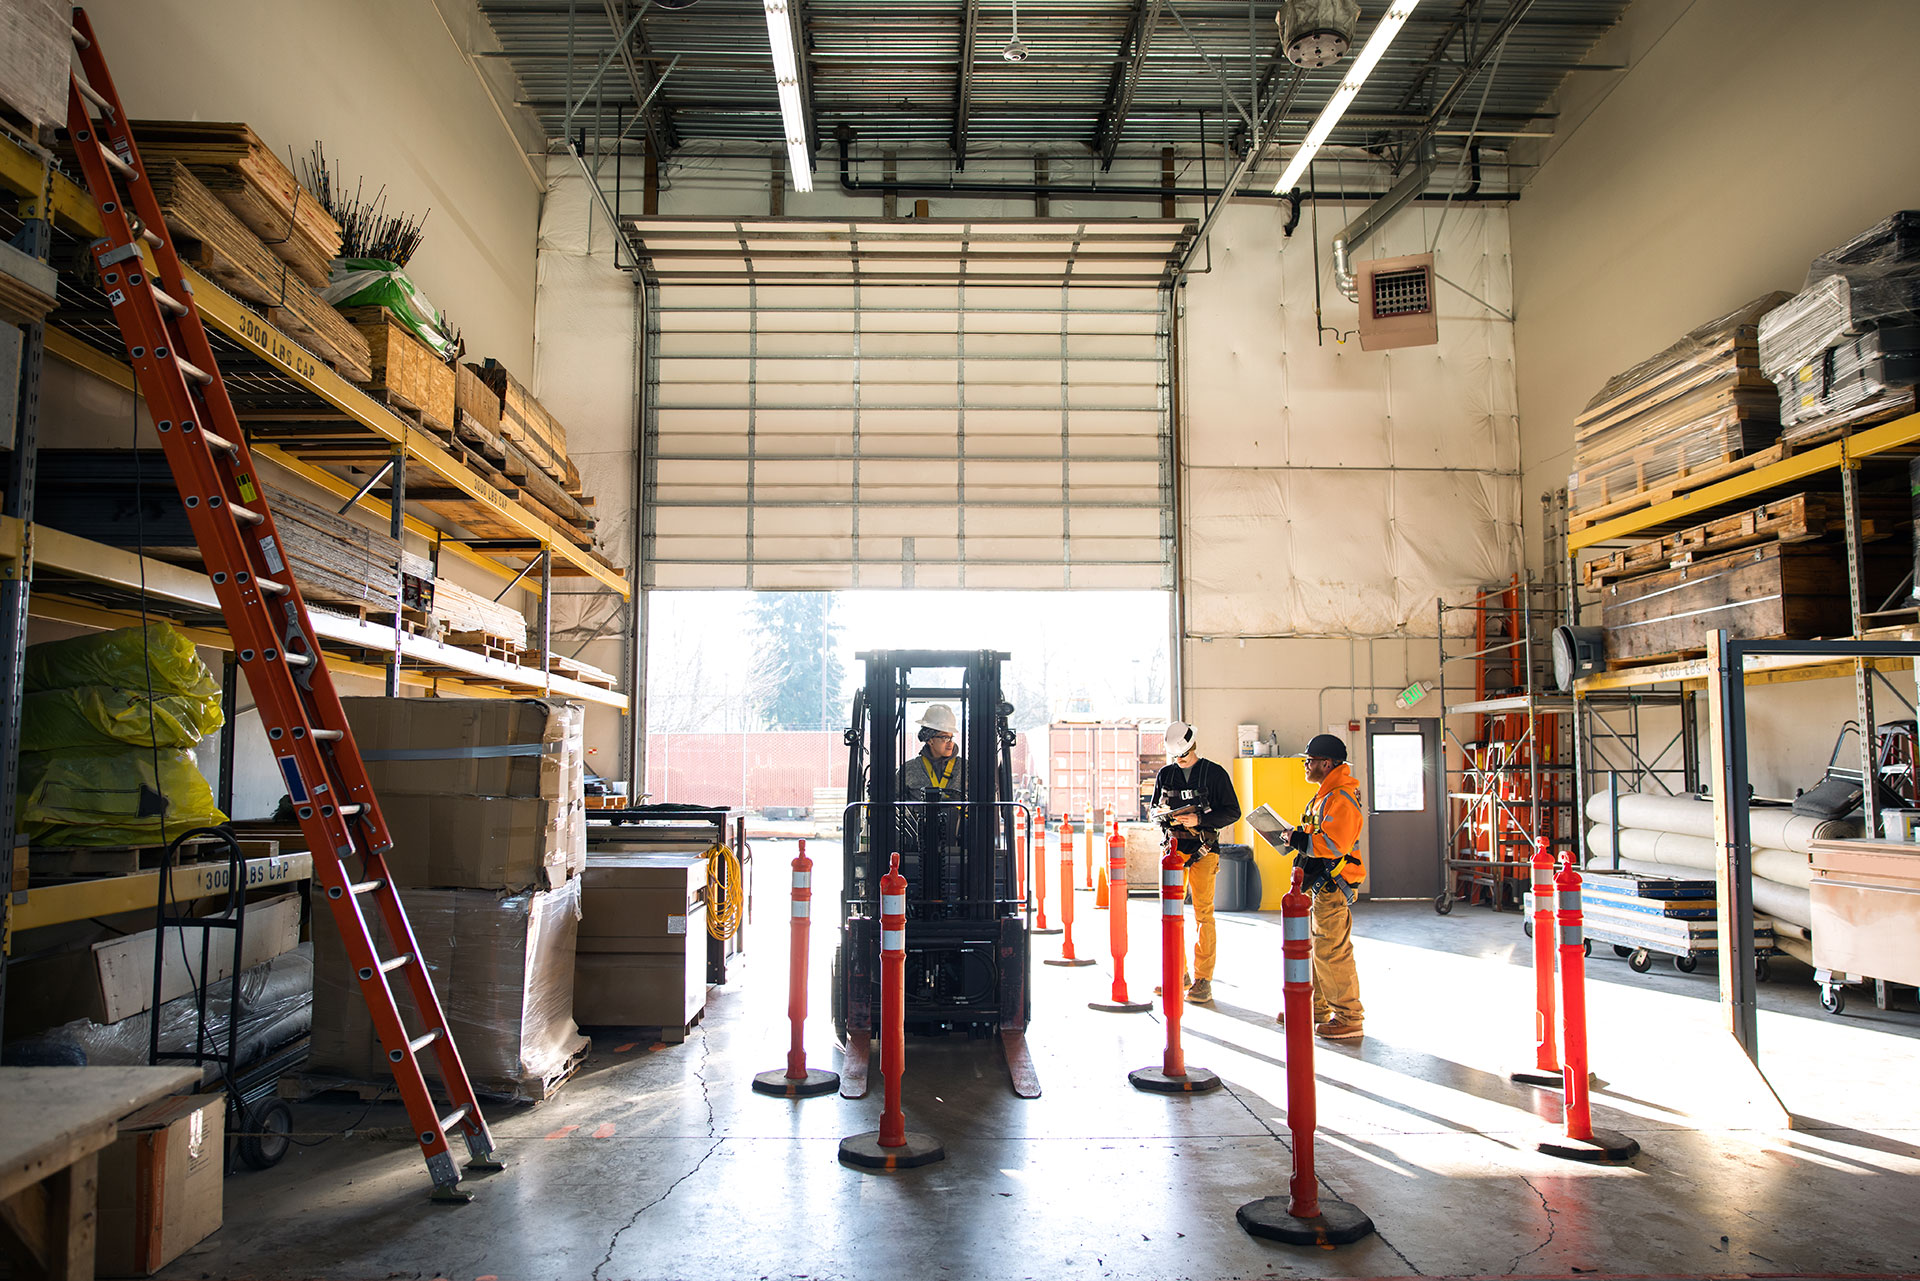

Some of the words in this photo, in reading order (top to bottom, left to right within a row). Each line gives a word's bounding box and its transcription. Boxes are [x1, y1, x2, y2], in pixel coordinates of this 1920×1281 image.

[239, 315, 268, 349] 3000
[272, 339, 292, 367] LBS
[296, 356, 315, 380] CAP
[1402, 684, 1423, 704] EXIT
[206, 869, 230, 890] 300
[246, 865, 263, 885] BS
[270, 861, 288, 880] CAP
